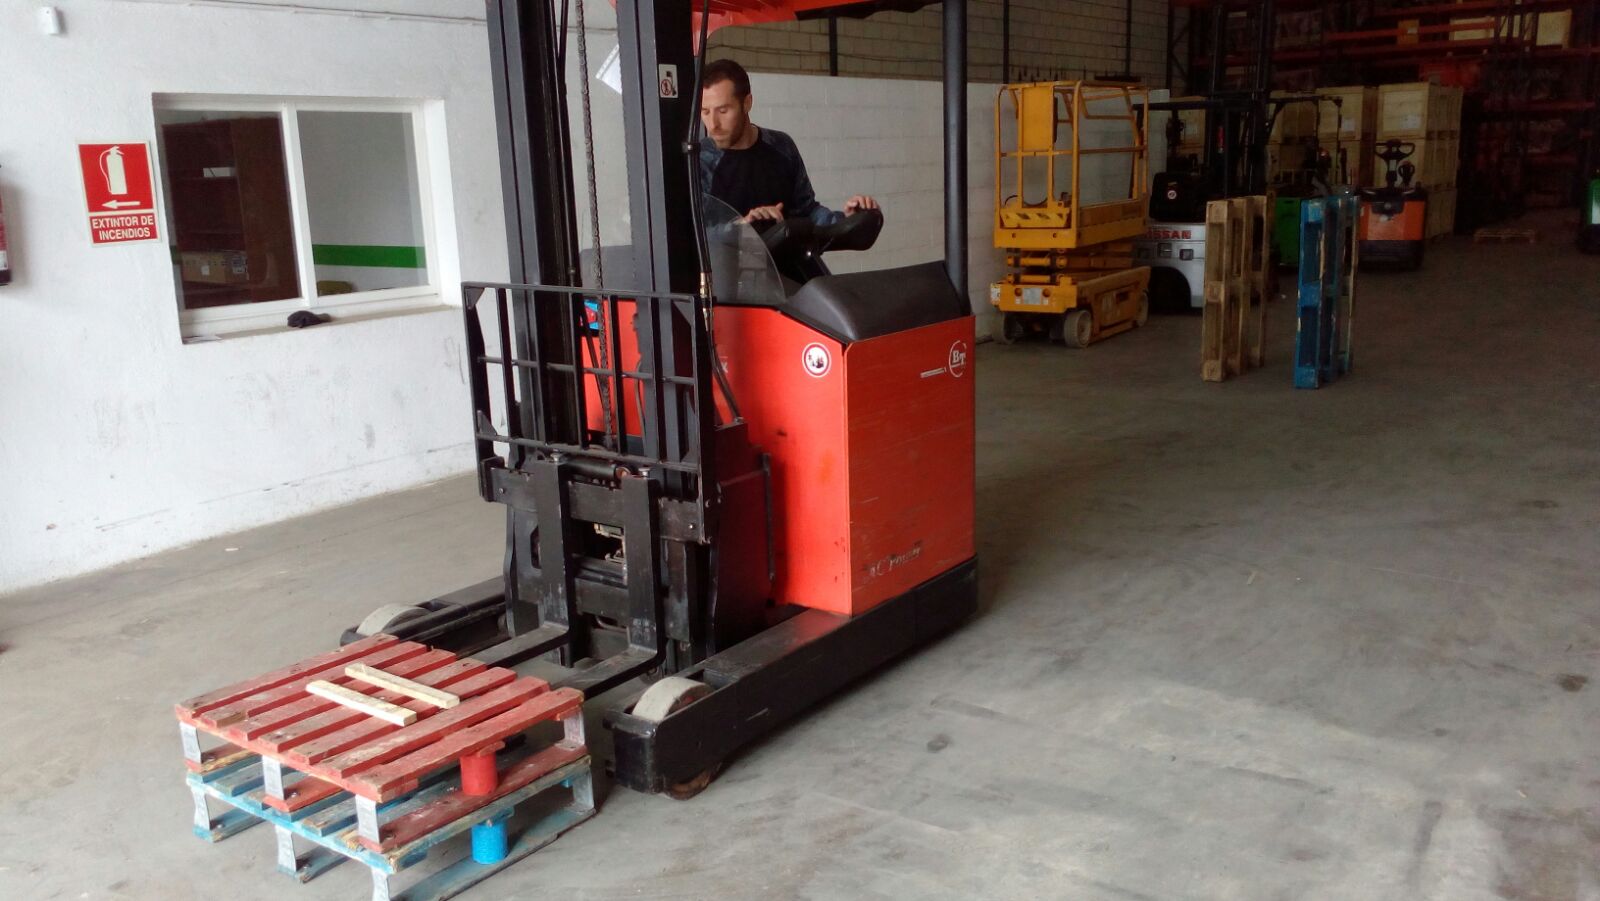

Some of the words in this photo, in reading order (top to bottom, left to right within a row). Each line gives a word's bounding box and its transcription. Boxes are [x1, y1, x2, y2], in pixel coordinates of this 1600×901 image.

[91, 216, 139, 229] EXTINTOR
[140, 215, 154, 226] DE
[99, 227, 151, 240] INCENDIOS
[952, 349, 967, 366] BT
